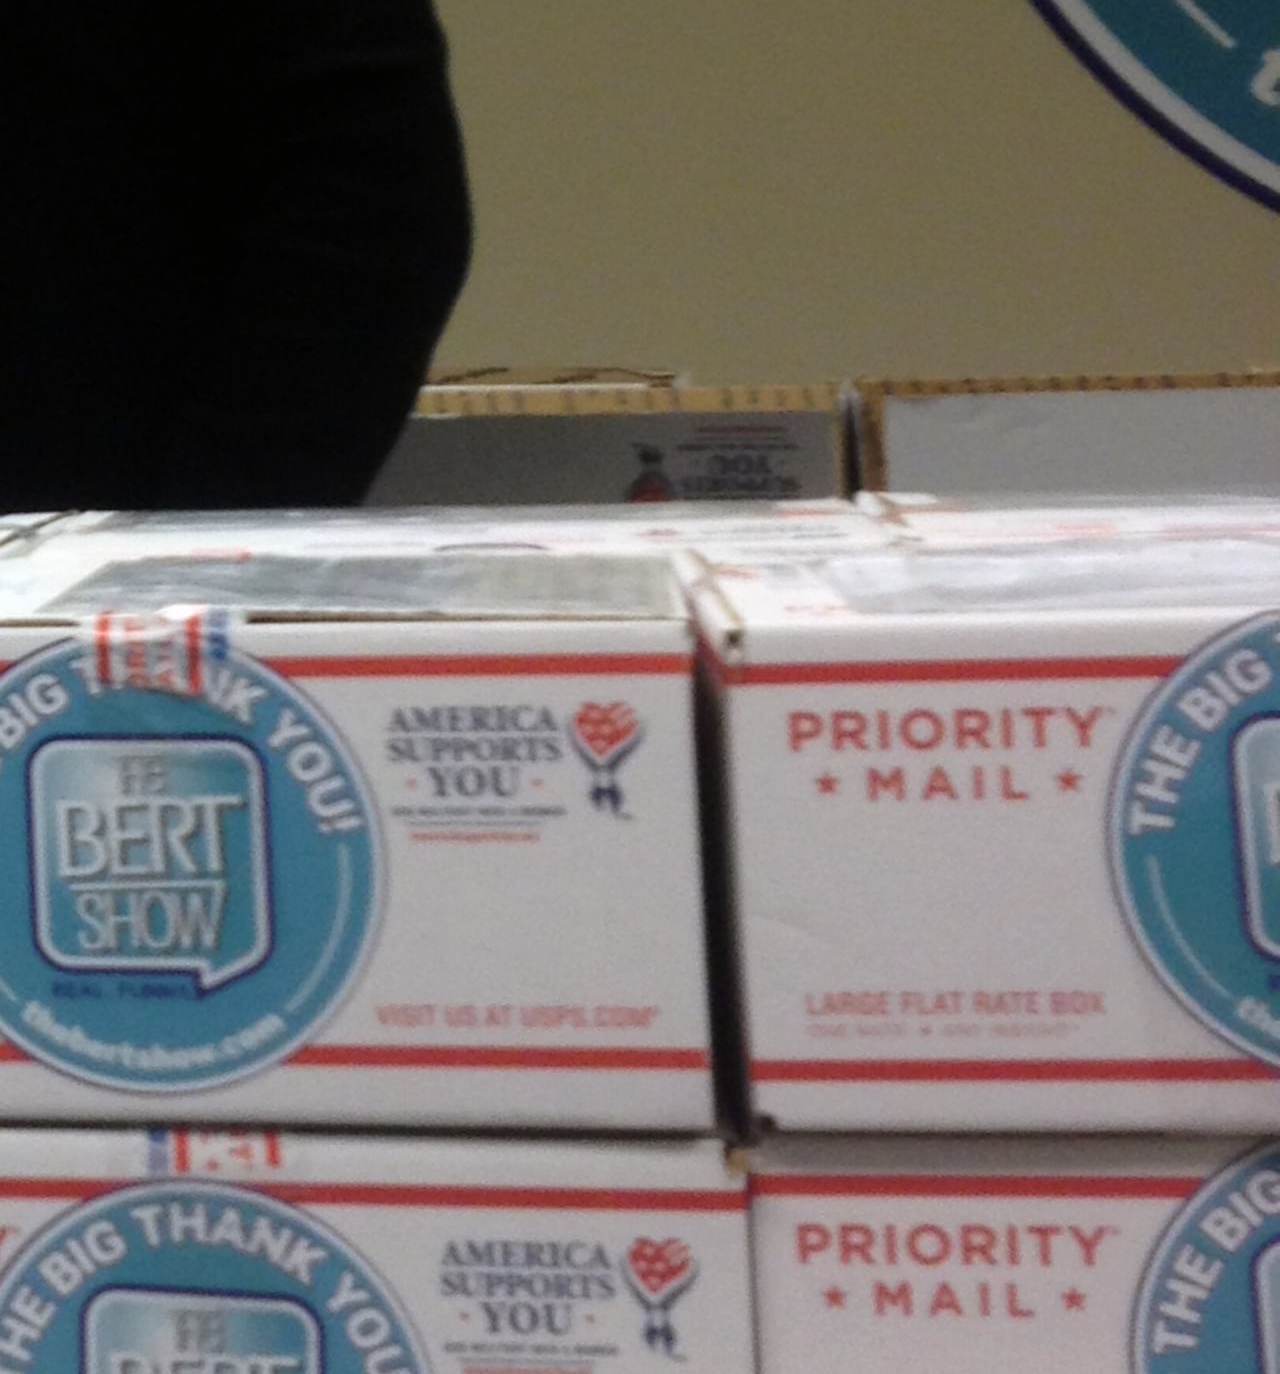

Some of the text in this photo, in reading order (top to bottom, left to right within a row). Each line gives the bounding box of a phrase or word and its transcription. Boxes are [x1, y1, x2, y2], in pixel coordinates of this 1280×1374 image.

[389, 706, 559, 733] AMERICA
[787, 706, 1106, 752] PRIORITY
[387, 737, 563, 763] SUPPORTS
[1128, 648, 1272, 837] THE BIG
[265, 707, 364, 836] YOU!
[426, 766, 522, 797] YOU
[866, 766, 1029, 802] MAIL
[56, 794, 248, 880] BERT
[74, 883, 227, 952] SHOW
[900, 991, 965, 1016] FLAT
[972, 991, 1038, 1015] RATE
[441, 1239, 612, 1269] AMERICA
[795, 1221, 1106, 1268] PRIORITY
[1152, 1169, 1280, 1356] THE BIG
[39, 1220, 128, 1298] BIG
[128, 1201, 330, 1287] THANK
[326, 1271, 410, 1374] YOU
[440, 1273, 616, 1299] SUPPORTS
[871, 1280, 1035, 1318] MAIL
[480, 1301, 575, 1334] YOU
